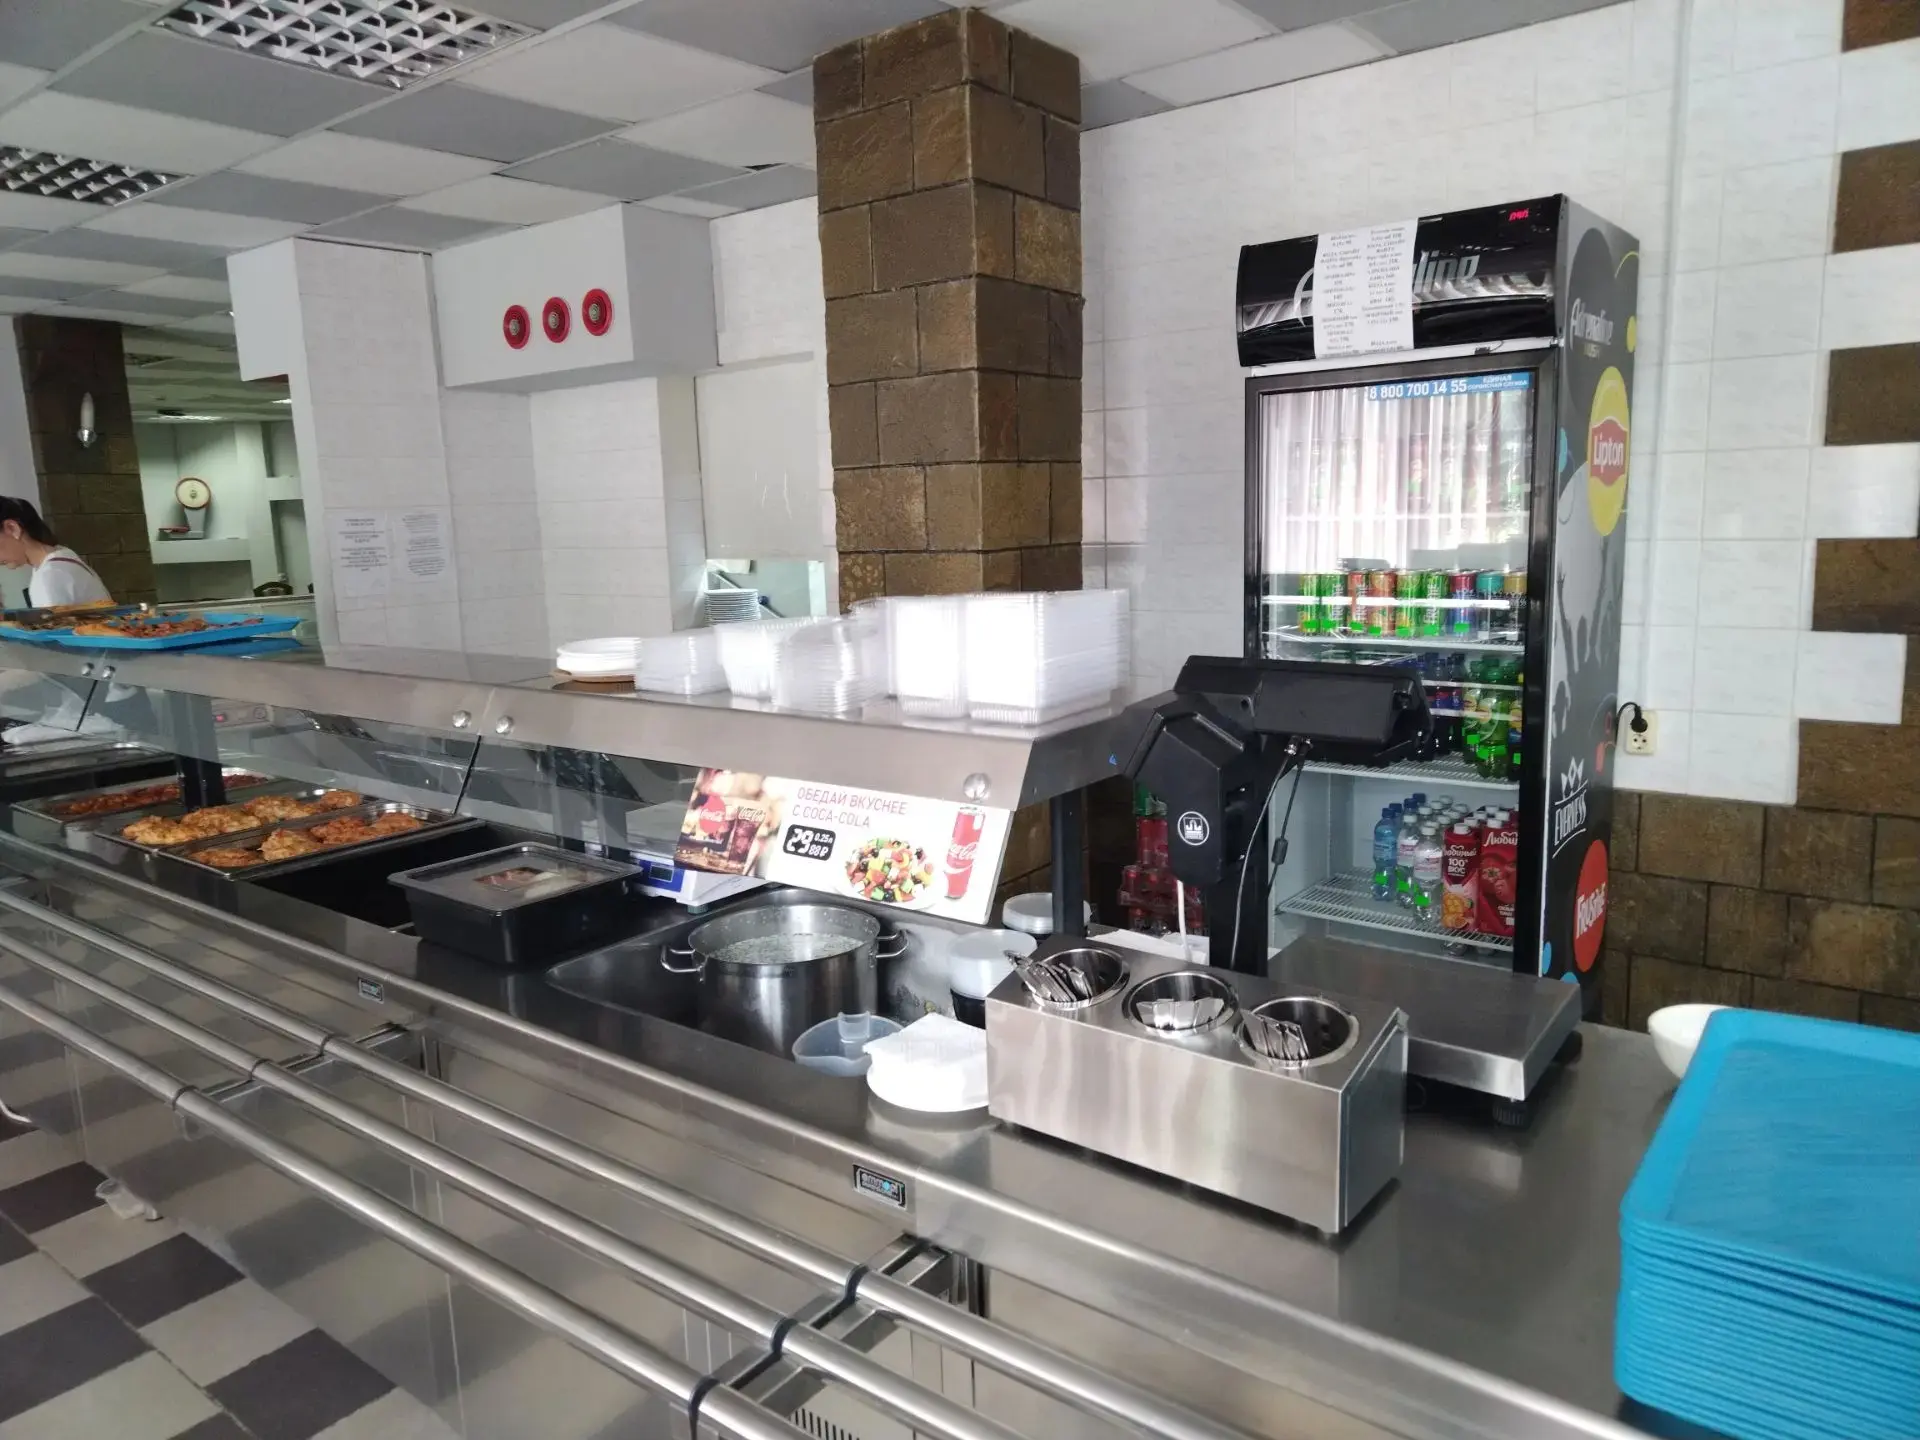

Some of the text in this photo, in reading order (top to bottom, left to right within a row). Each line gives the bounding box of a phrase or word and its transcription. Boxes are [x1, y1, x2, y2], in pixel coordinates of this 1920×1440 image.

[1369, 379, 1468, 399] 8 800 700 14 55
[1593, 432, 1624, 474] Lipton
[797, 786, 908, 815] ОБЕДАЙ ВКУСНЕЕ
[803, 806, 870, 828] COCA-COLA
